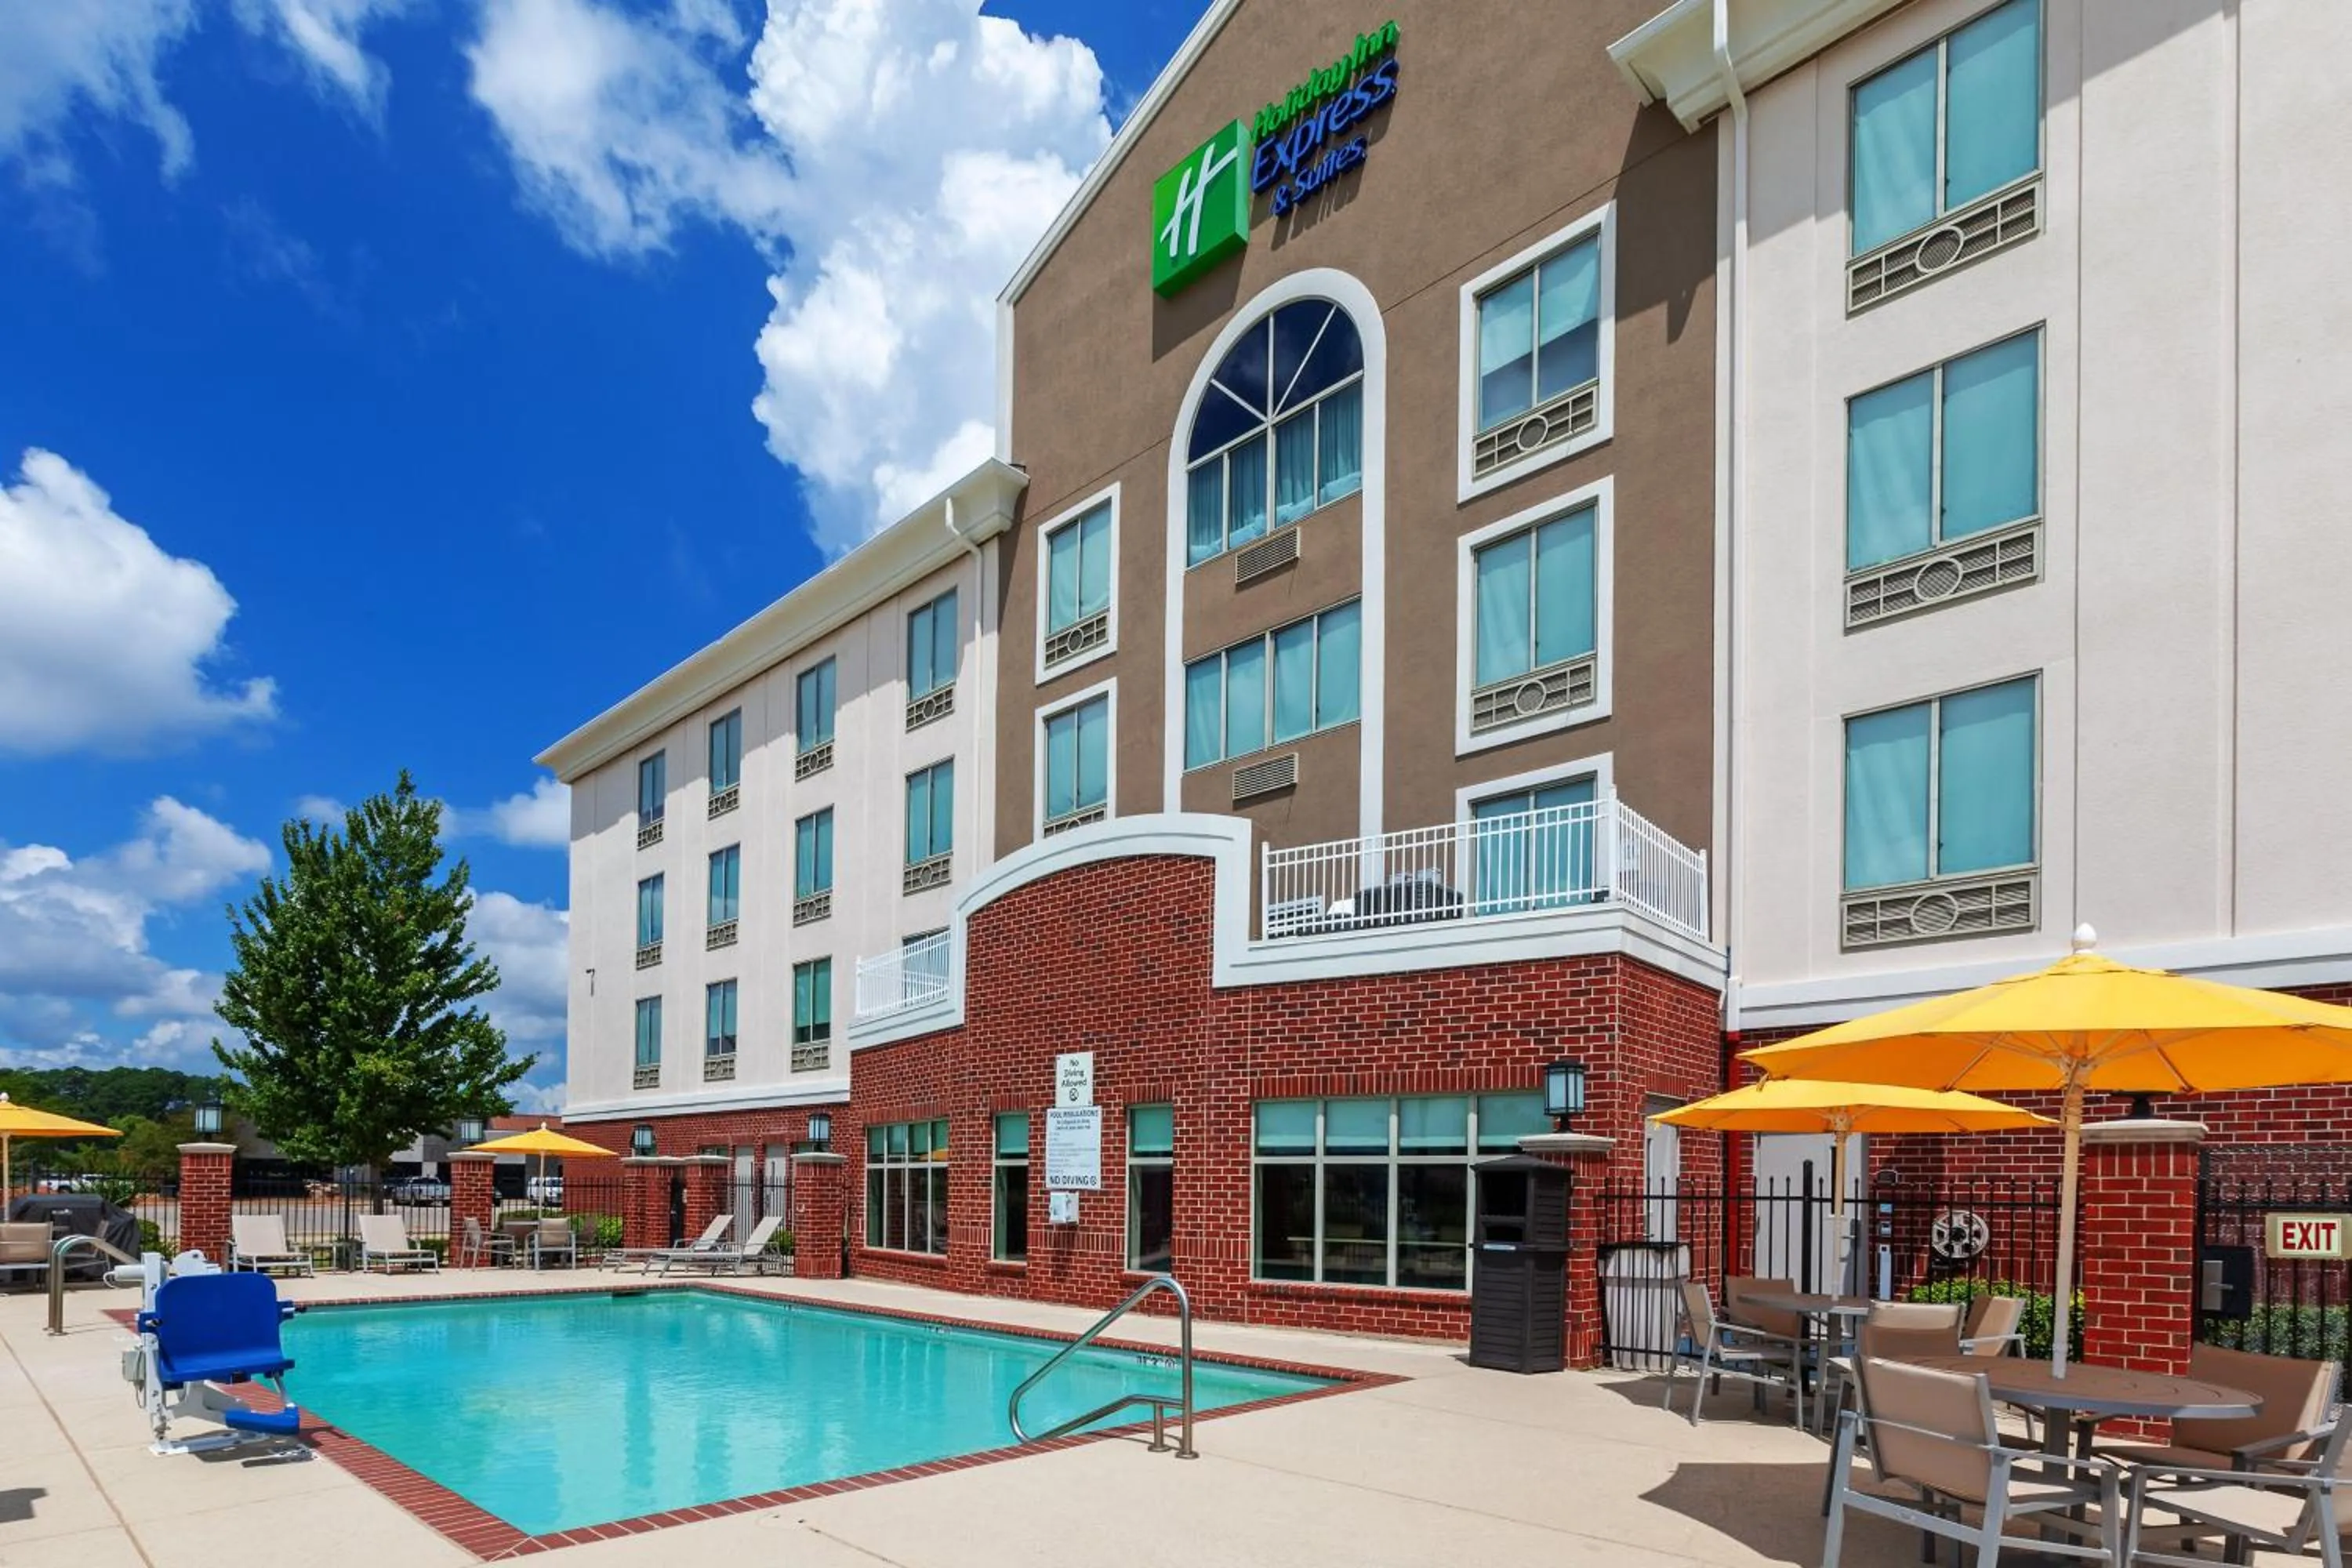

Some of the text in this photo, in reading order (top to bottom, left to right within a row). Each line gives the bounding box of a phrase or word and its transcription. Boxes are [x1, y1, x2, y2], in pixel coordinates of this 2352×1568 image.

[1252, 20, 1400, 144] Holiday Inn
[1251, 57, 1399, 194] Express
[1271, 135, 1367, 216] & Suites
[1069, 1058, 1080, 1067] No
[1061, 1078, 1087, 1087] Allowed
[1063, 1068, 1084, 1078] Diving
[1050, 1175, 1089, 1185] NO DIVING
[2282, 1221, 2336, 1250] EXIT
